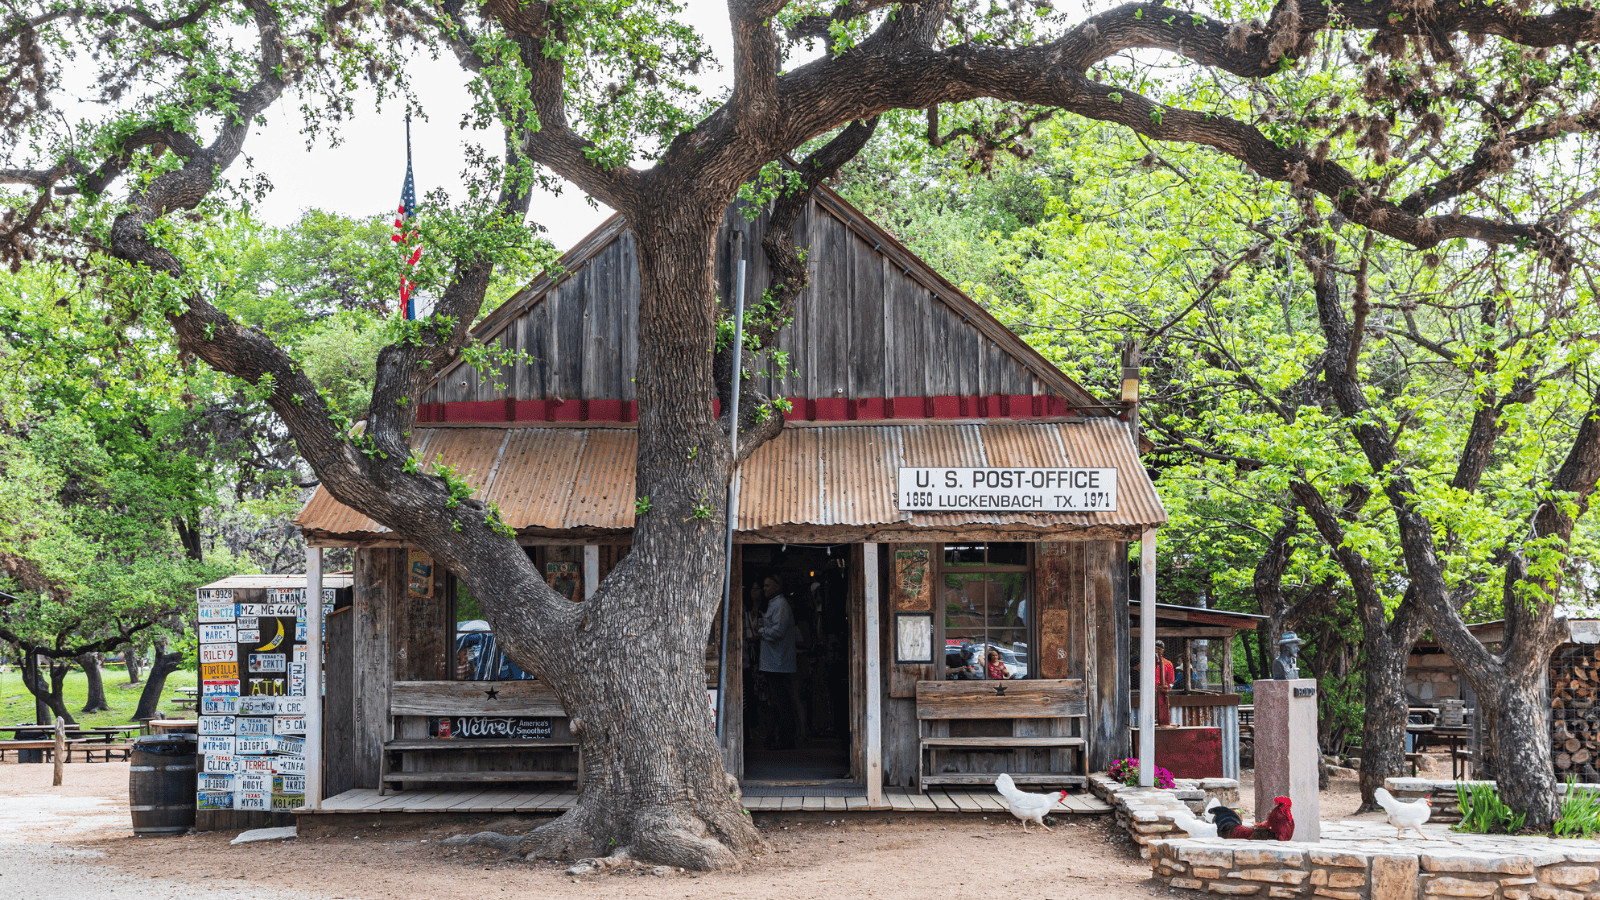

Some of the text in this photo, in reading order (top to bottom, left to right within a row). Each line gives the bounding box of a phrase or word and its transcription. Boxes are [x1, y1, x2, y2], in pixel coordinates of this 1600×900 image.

[916, 471, 1100, 488] U. S. POST-OFFICE
[906, 492, 1110, 507] 1850 LUCKENBACH TX. 1971
[215, 590, 232, 598] 9928
[270, 594, 300, 603] ALEMAN
[220, 608, 233, 617] CTZ
[241, 605, 254, 615] MZ
[261, 605, 274, 615] MG
[277, 605, 296, 615] 444
[262, 660, 284, 668] CRKTT
[203, 665, 237, 675] TORTILLA
[251, 679, 284, 696] ATM
[222, 702, 235, 711] 770
[286, 703, 301, 712] CRC
[286, 720, 291, 730] 5
[456, 717, 517, 737] Velvet
[519, 720, 549, 728] America's
[516, 727, 551, 735] Smoothest
[239, 741, 269, 751] 1BIGPIG
[245, 760, 274, 770] TERRELL
[283, 762, 306, 771] KINFA
